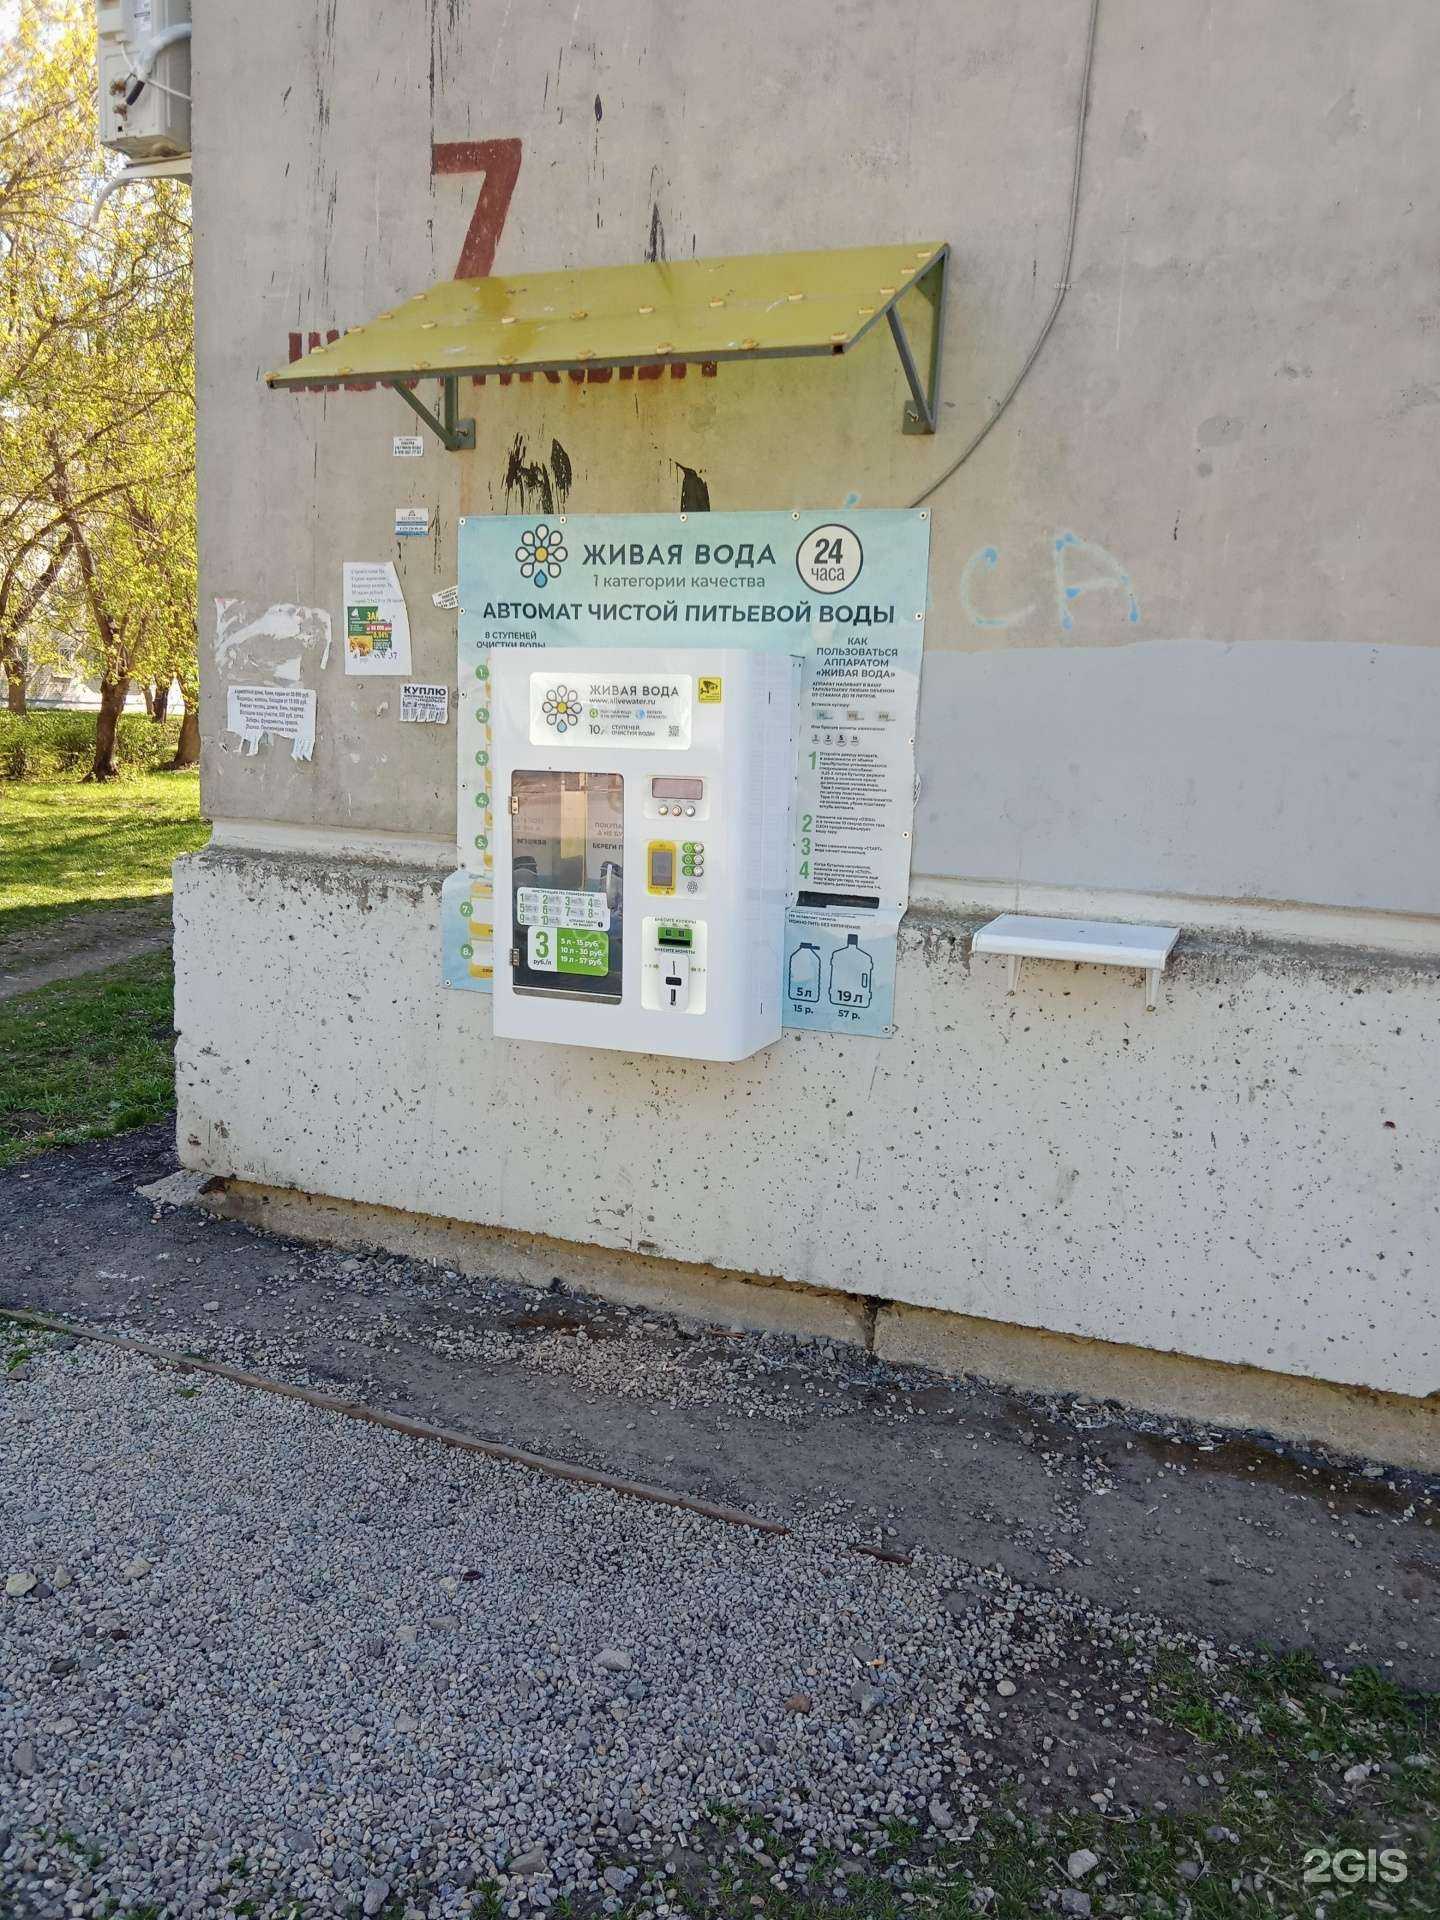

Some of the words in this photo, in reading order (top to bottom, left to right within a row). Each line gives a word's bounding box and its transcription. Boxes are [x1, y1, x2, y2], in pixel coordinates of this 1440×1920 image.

[432, 138, 522, 280] 7
[582, 543, 684, 566] ЖИВАЯ
[694, 543, 777, 567] ВОДА
[813, 538, 844, 565] 24
[811, 567, 846, 582] часа
[593, 576, 600, 588] 1
[602, 577, 686, 590] категории
[690, 576, 766, 589] качества
[483, 602, 582, 621] АВТОМАТ
[587, 600, 678, 622] ЧИСТОЙ
[684, 600, 811, 623] ПИТЬЕВОЙ
[819, 605, 895, 626] ВОДЫ
[492, 631, 537, 640] СТУПЕНЕЙ
[847, 637, 868, 646] КАК
[816, 647, 898, 657] ПОЛЬЗОВАТЬСЯ
[824, 658, 889, 667] АППАРАТОМ
[816, 669, 859, 678] «ЖИВАЯ
[861, 669, 896, 679] ВОДА»
[403, 686, 447, 696] КУПЛЮ
[590, 684, 637, 696] ЖИВАЯ
[642, 685, 680, 698] ВОДА
[809, 751, 817, 769] 1
[802, 814, 813, 832] 2
[801, 838, 811, 855] 3
[799, 861, 810, 879] 4
[543, 895, 548, 904] 2
[565, 897, 570, 905] 3
[588, 898, 593, 907] 4
[536, 931, 549, 958] 3
[797, 987, 803, 996] 5
[804, 989, 812, 998] л
[837, 990, 851, 1001] 19
[853, 993, 863, 1003] л
[793, 1004, 802, 1013] 15
[805, 1007, 814, 1015] р.
[838, 1009, 849, 1018] 57
[851, 1012, 861, 1020] р.
